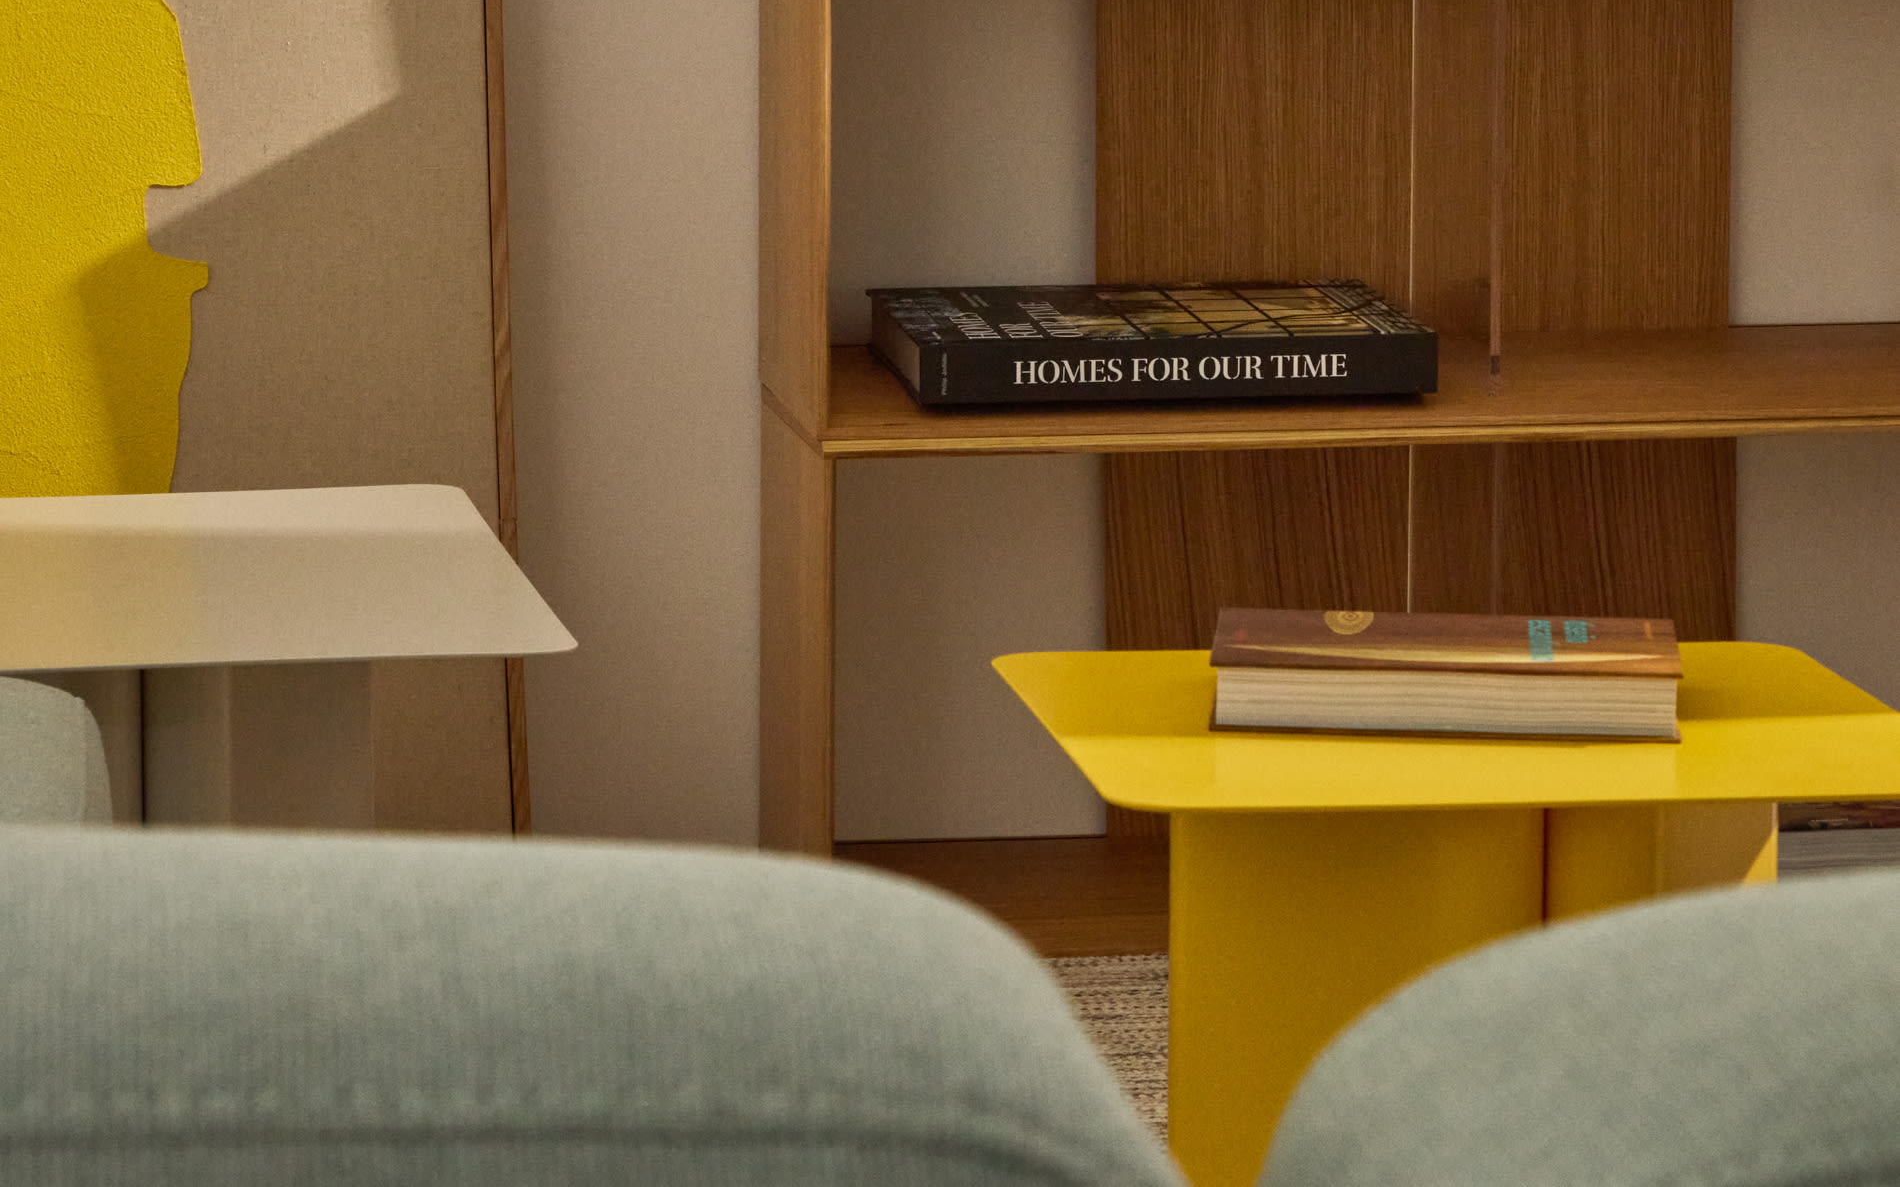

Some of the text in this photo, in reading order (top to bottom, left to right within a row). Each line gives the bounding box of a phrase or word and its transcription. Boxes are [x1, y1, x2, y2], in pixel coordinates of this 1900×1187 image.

[1013, 353, 1347, 385] HOMES FOR OUR TIME
